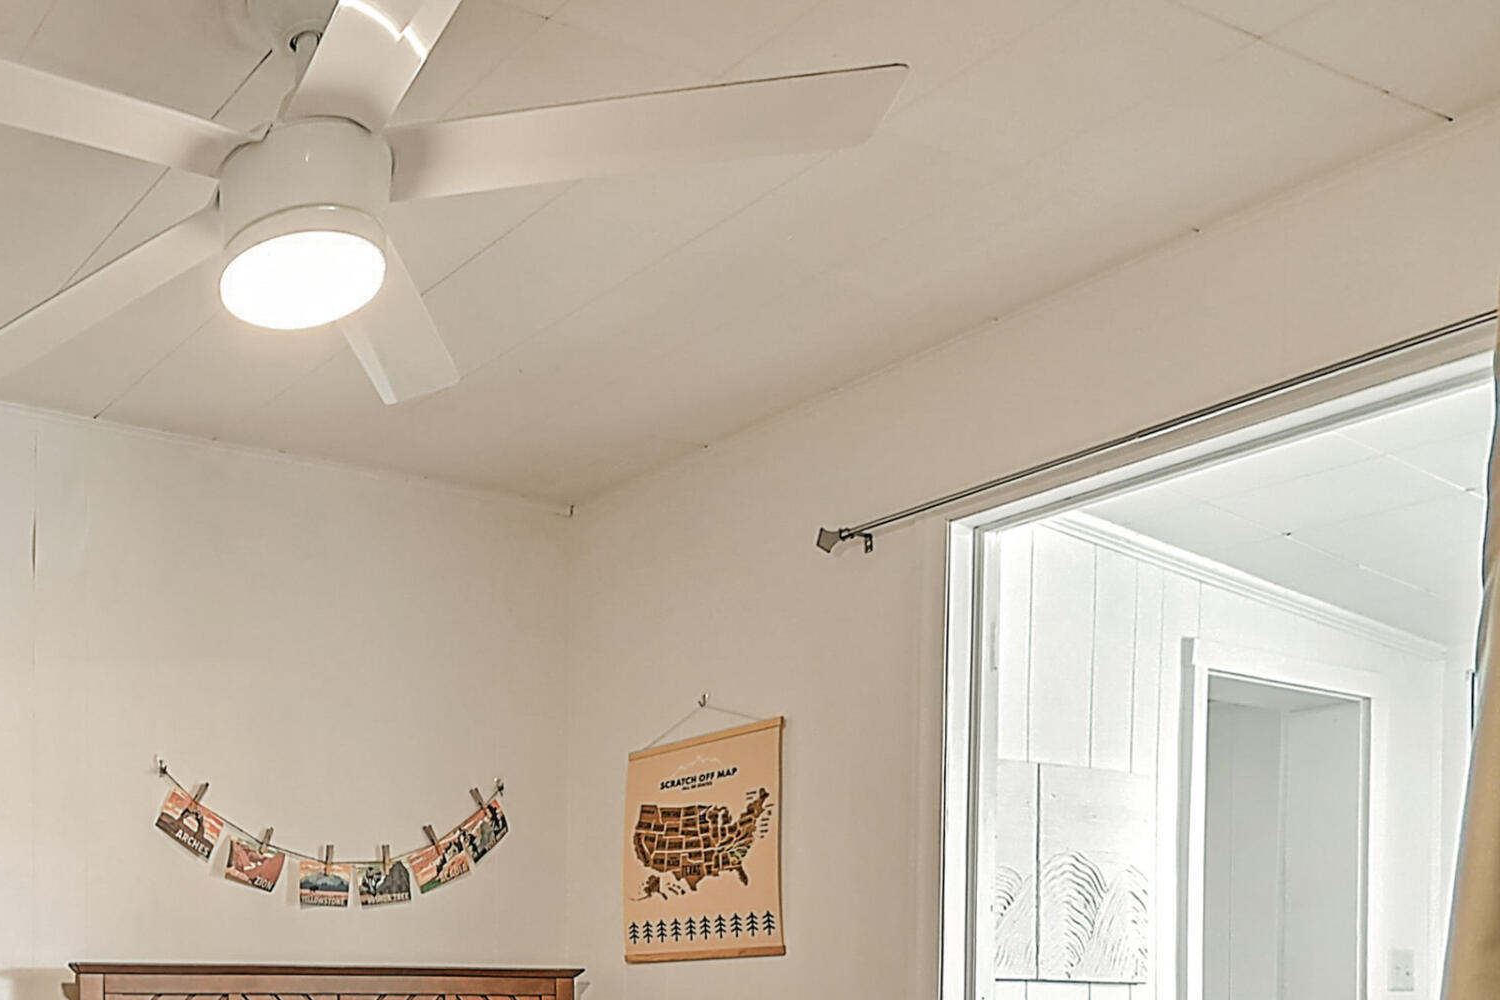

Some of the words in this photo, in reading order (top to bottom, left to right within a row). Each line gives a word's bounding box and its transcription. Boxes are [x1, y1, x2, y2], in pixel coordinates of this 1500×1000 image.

[660, 775, 697, 790] SCRATCH
[699, 771, 715, 782] OFF
[717, 767, 738, 779] MAP
[175, 829, 210, 856] ARCHES
[253, 876, 274, 890] ZION
[301, 895, 345, 906] YELLOWSTONE
